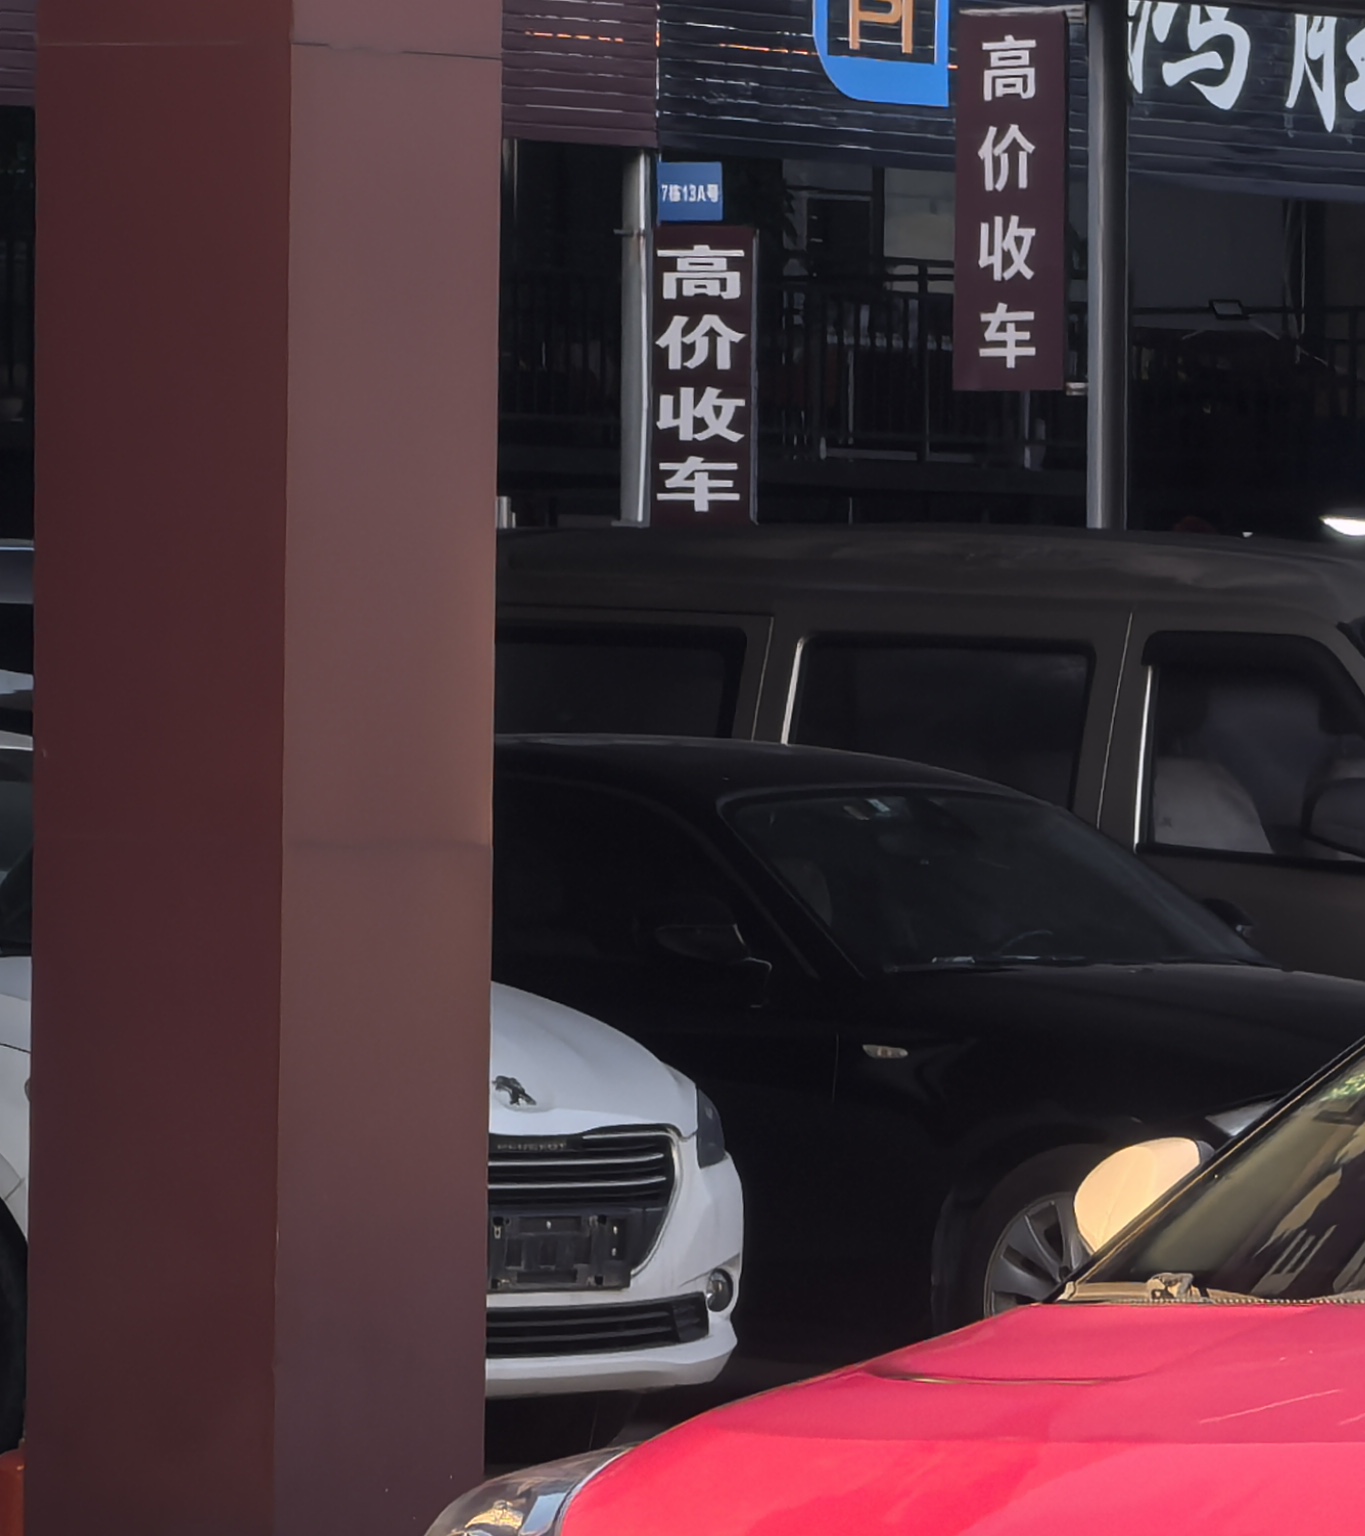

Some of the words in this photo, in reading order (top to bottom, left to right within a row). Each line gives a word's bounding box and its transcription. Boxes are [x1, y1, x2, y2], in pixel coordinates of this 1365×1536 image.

[978, 35, 1037, 369] 高价收车
[656, 244, 745, 512] 高价收车
